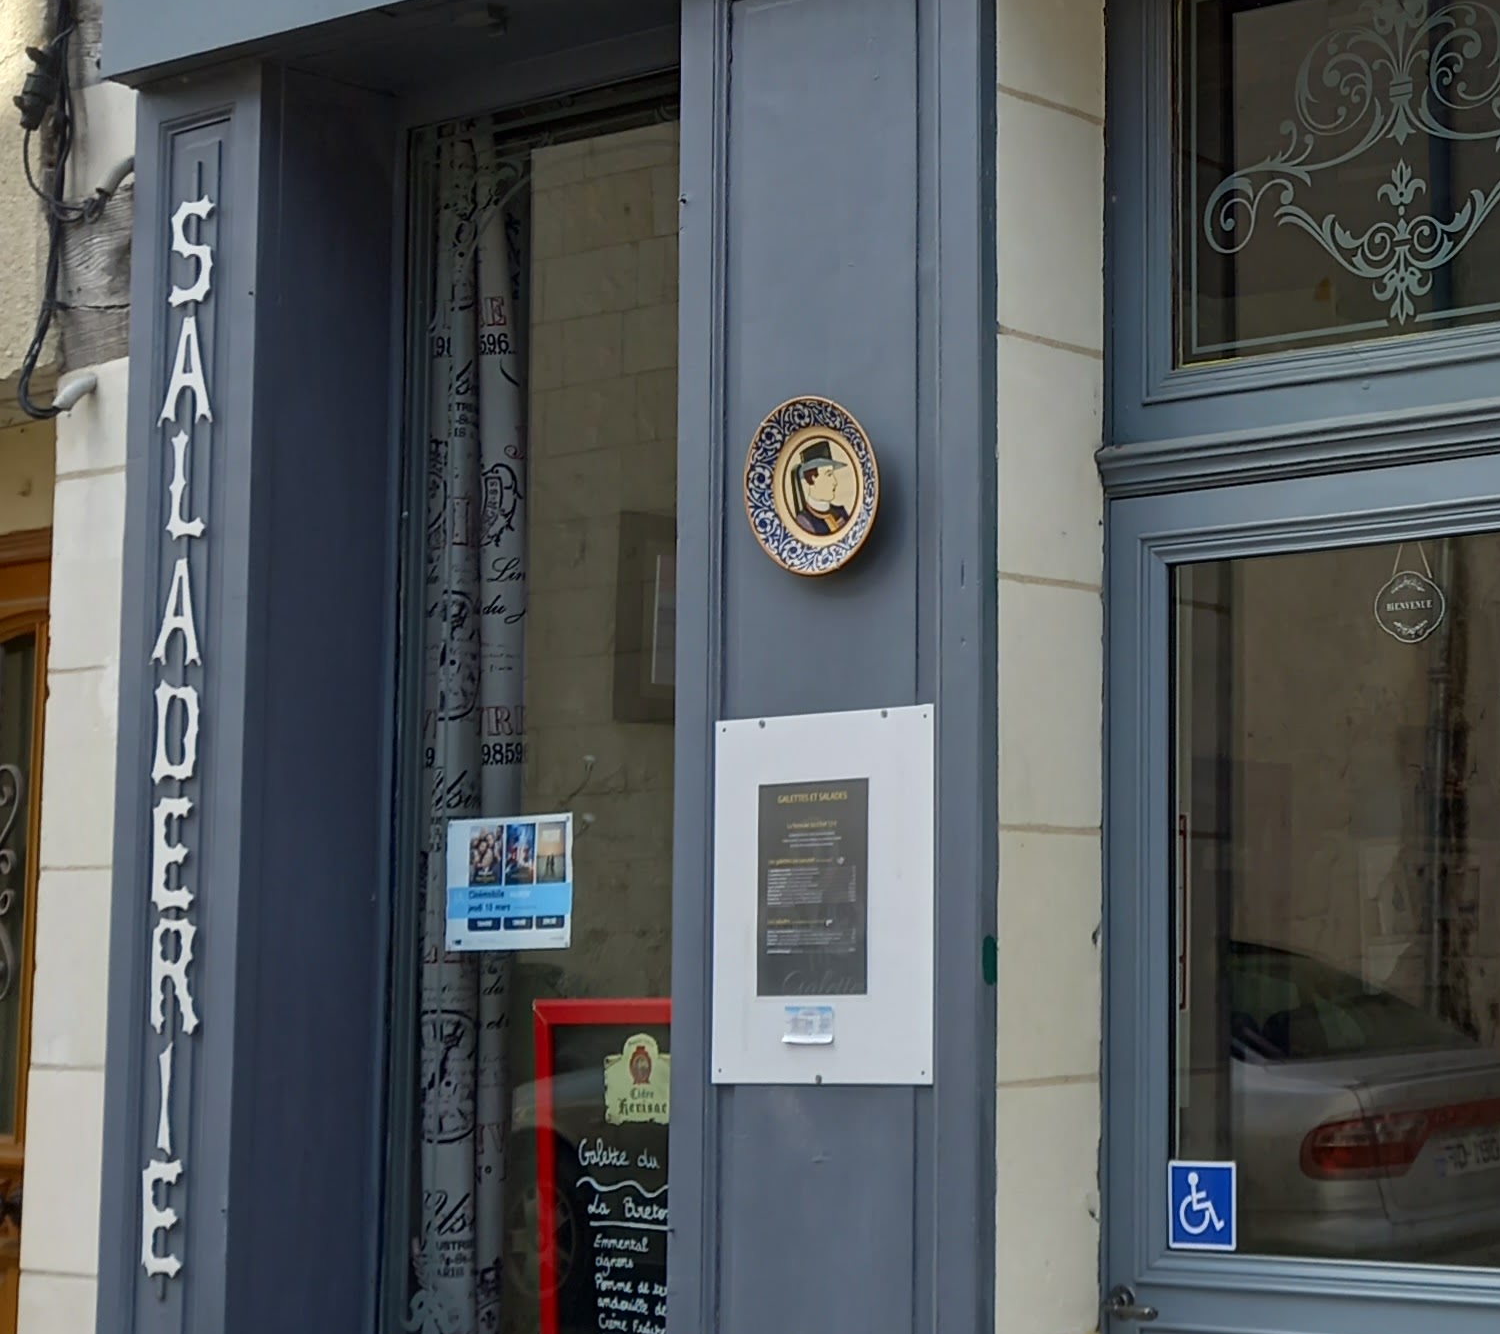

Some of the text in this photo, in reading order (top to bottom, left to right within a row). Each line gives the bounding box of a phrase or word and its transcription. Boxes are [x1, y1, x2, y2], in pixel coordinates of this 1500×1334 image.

[1386, 599, 1433, 612] BIENVENUE
[140, 194, 216, 1280] SALADERIE
[578, 1136, 660, 1169] Galette du
[587, 1192, 612, 1216] La
[593, 1233, 649, 1253] Emmental
[637, 1281, 650, 1295] de
[597, 1295, 650, 1315] andouille
